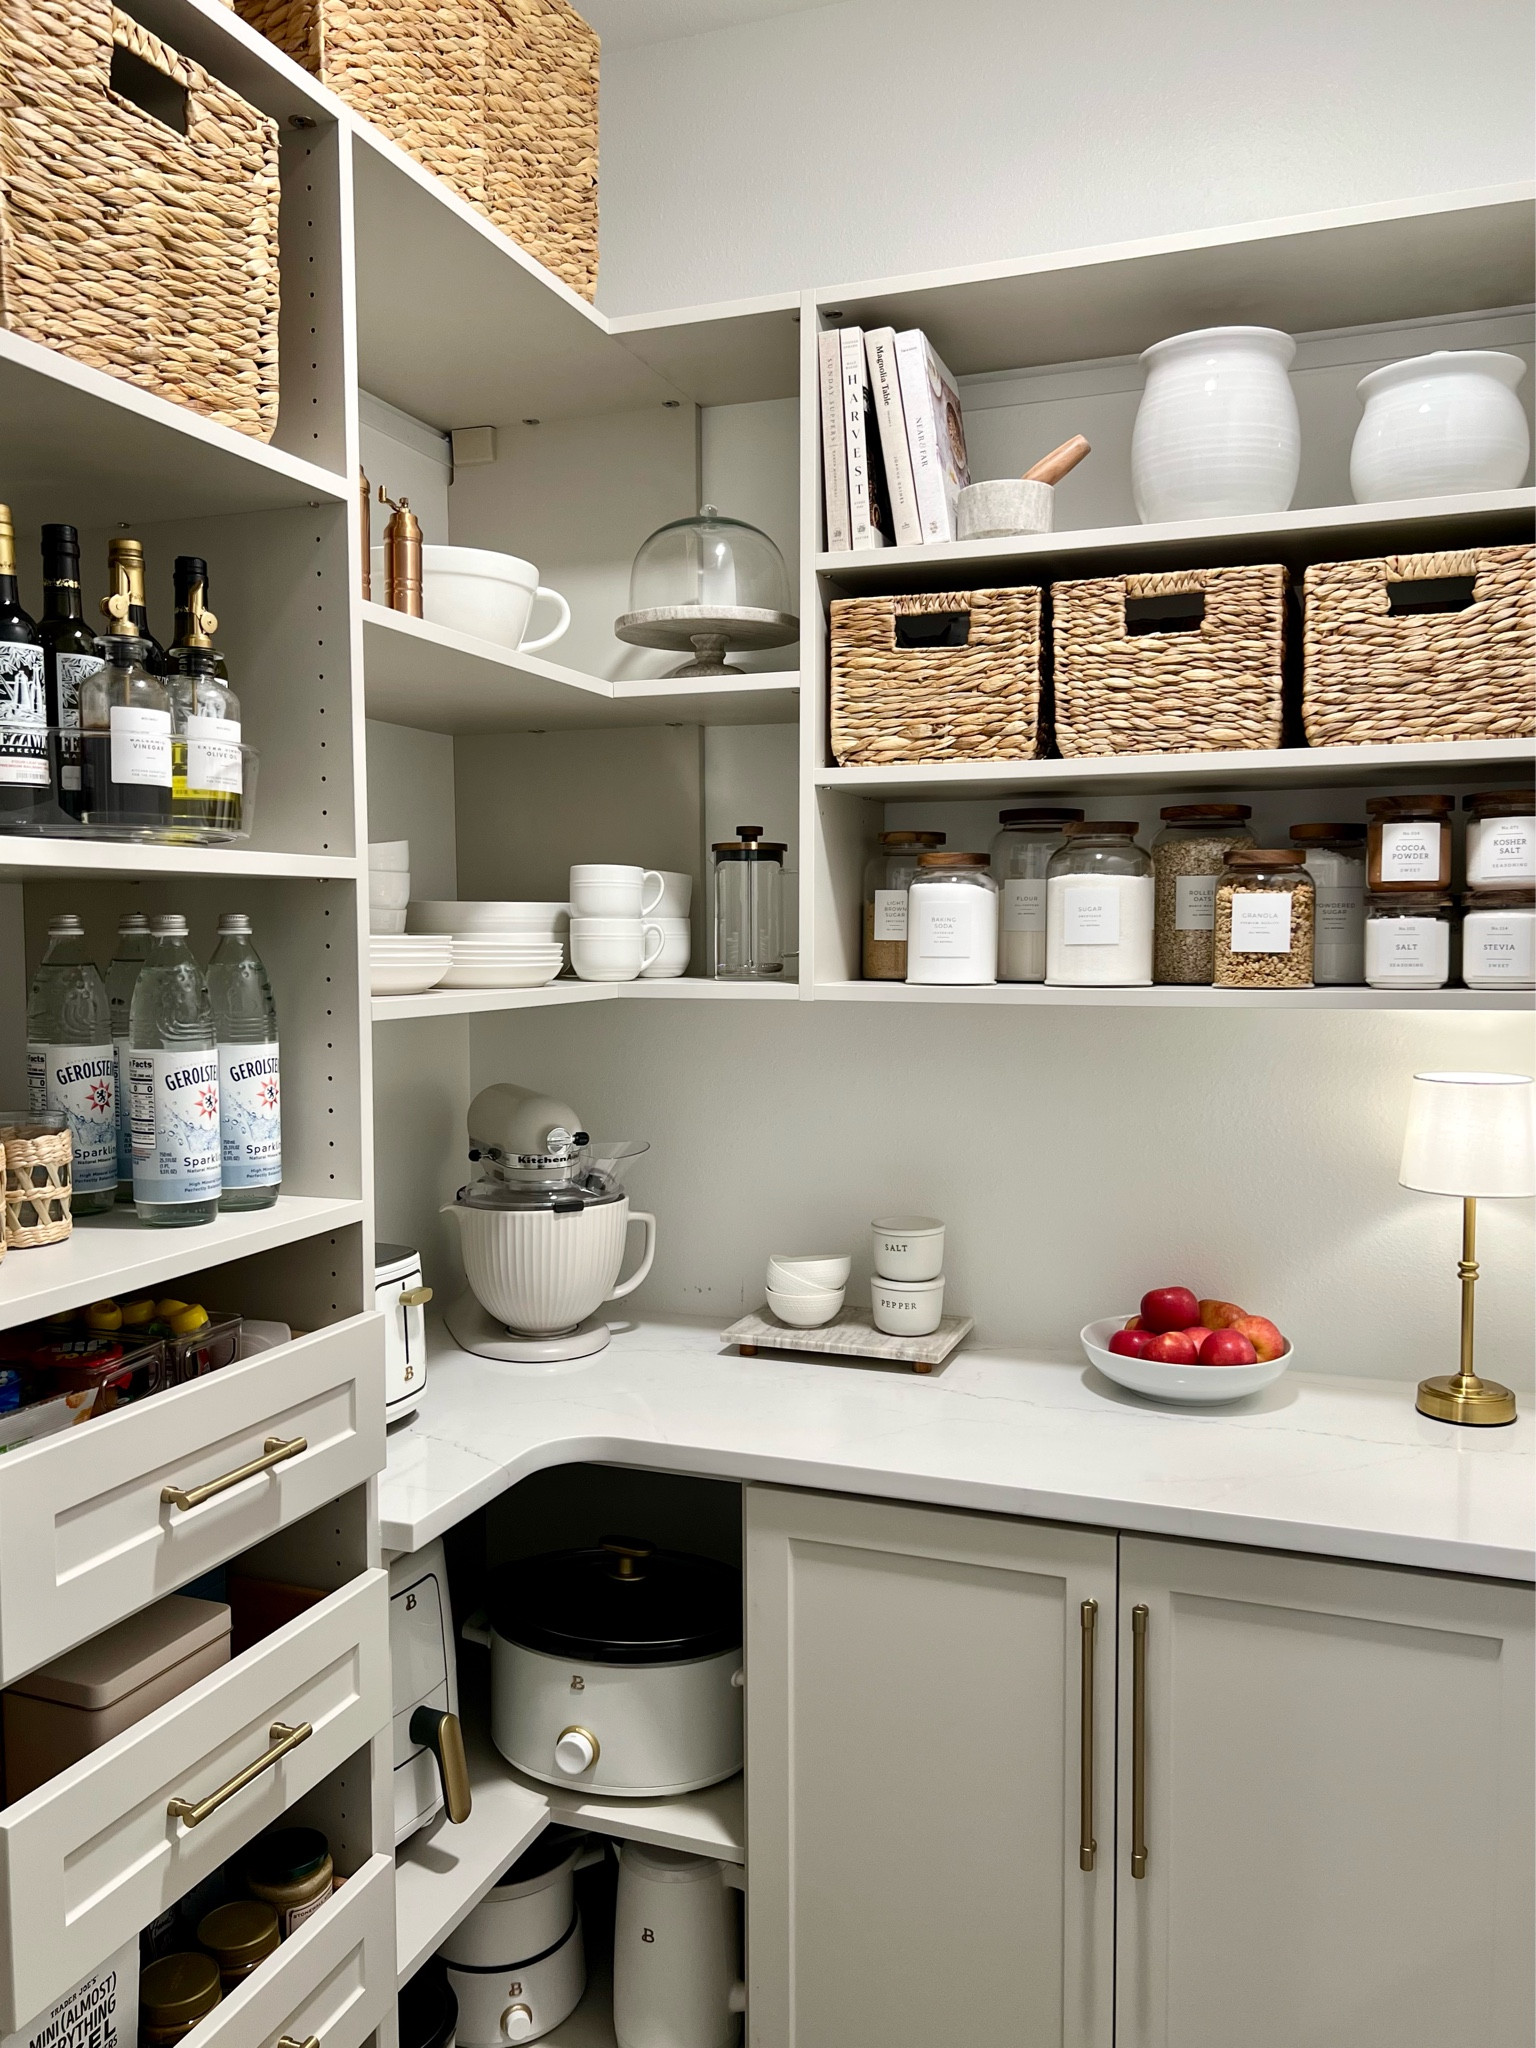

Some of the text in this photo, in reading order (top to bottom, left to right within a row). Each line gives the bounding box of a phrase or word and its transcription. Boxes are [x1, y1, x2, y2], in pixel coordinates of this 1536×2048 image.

[827, 358, 835, 396] SUNDAY
[876, 345, 888, 383] Magnolia
[882, 383, 891, 406] Table
[829, 401, 837, 442] SUPPERS
[848, 374, 864, 495] HARVEST
[133, 743, 164, 751] VINEGAR
[132, 1060, 153, 1069] Facts
[885, 1243, 908, 1252] SALT
[881, 1299, 917, 1310] PEPPER
[29, 1970, 117, 2048] MINI (ALMOST)
[50, 1975, 97, 2018] TRADER JOE'S
